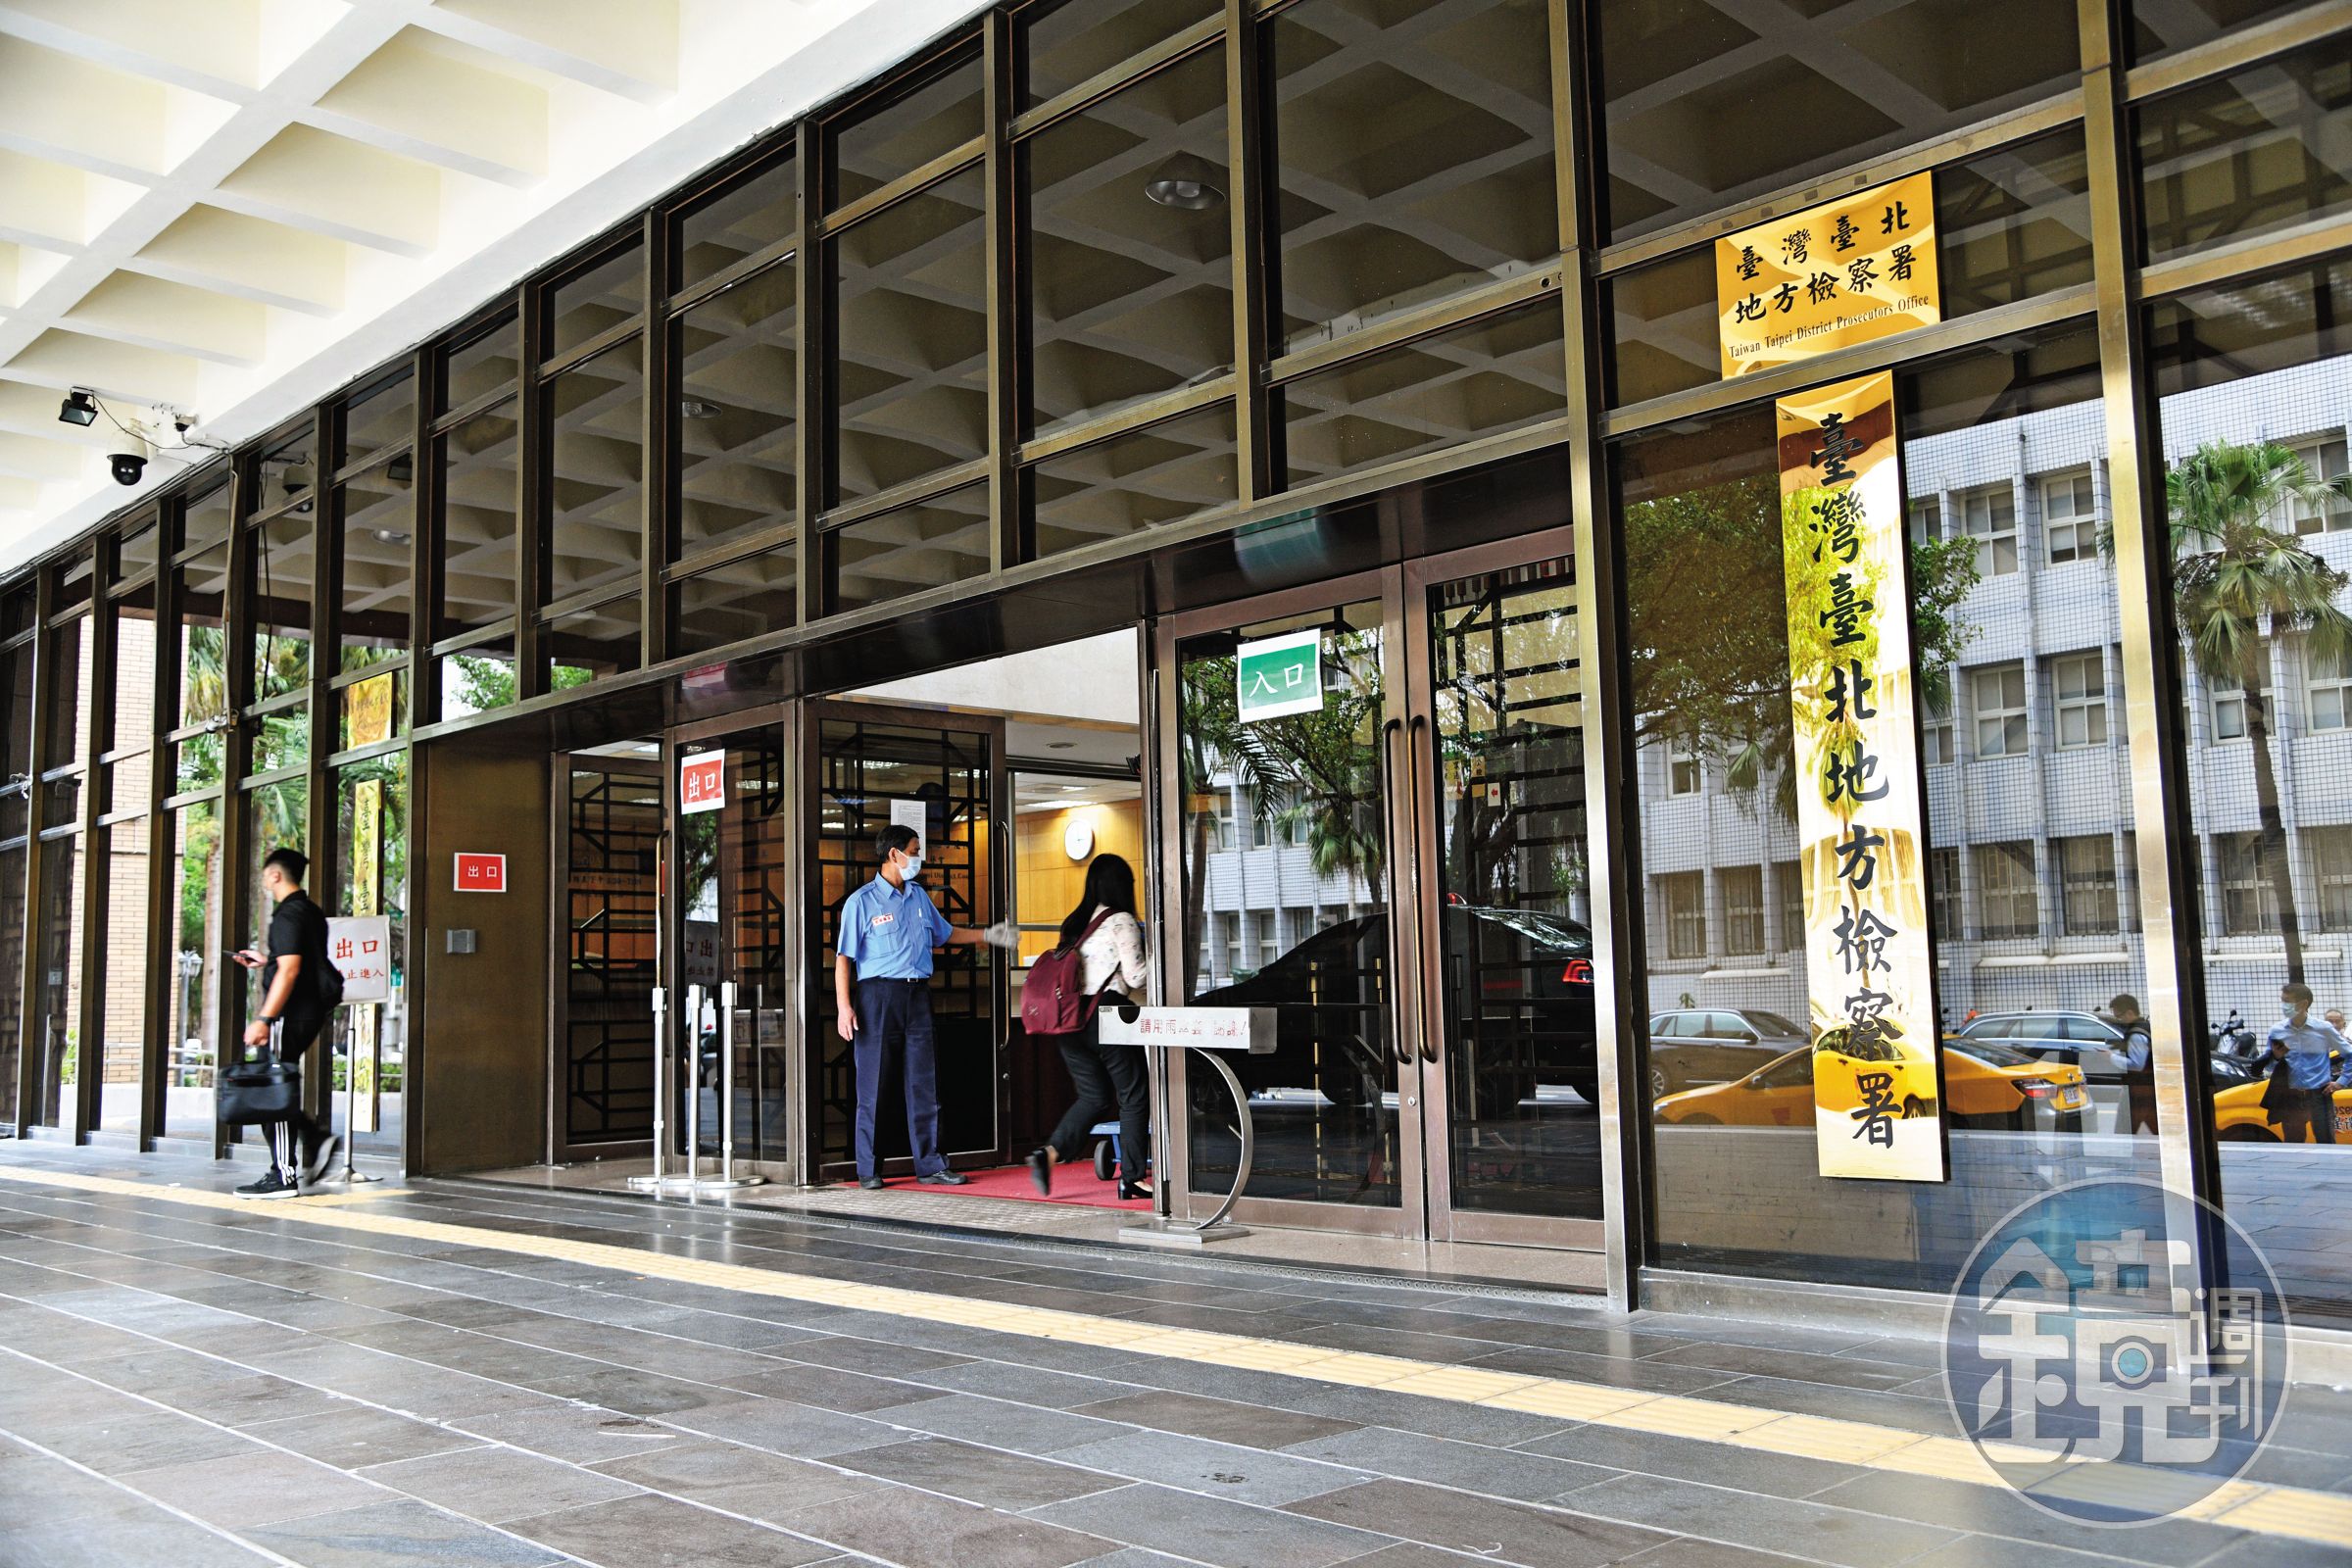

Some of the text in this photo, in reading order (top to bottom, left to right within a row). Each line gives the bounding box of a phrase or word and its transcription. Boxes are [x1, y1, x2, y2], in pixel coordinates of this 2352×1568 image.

[1736, 200, 1910, 281] 臺灣臺北
[1735, 243, 1917, 324] 地方檢察署
[1729, 295, 1930, 359] Taiwan Taipei District Prosecutors Office
[1250, 662, 1303, 698] 入口
[688, 771, 716, 799] 出口
[1808, 412, 1904, 1150] 臺灣臺北地方檢察署
[467, 864, 498, 878] 出口
[336, 937, 379, 959] 出口
[337, 968, 384, 980] 止進入
